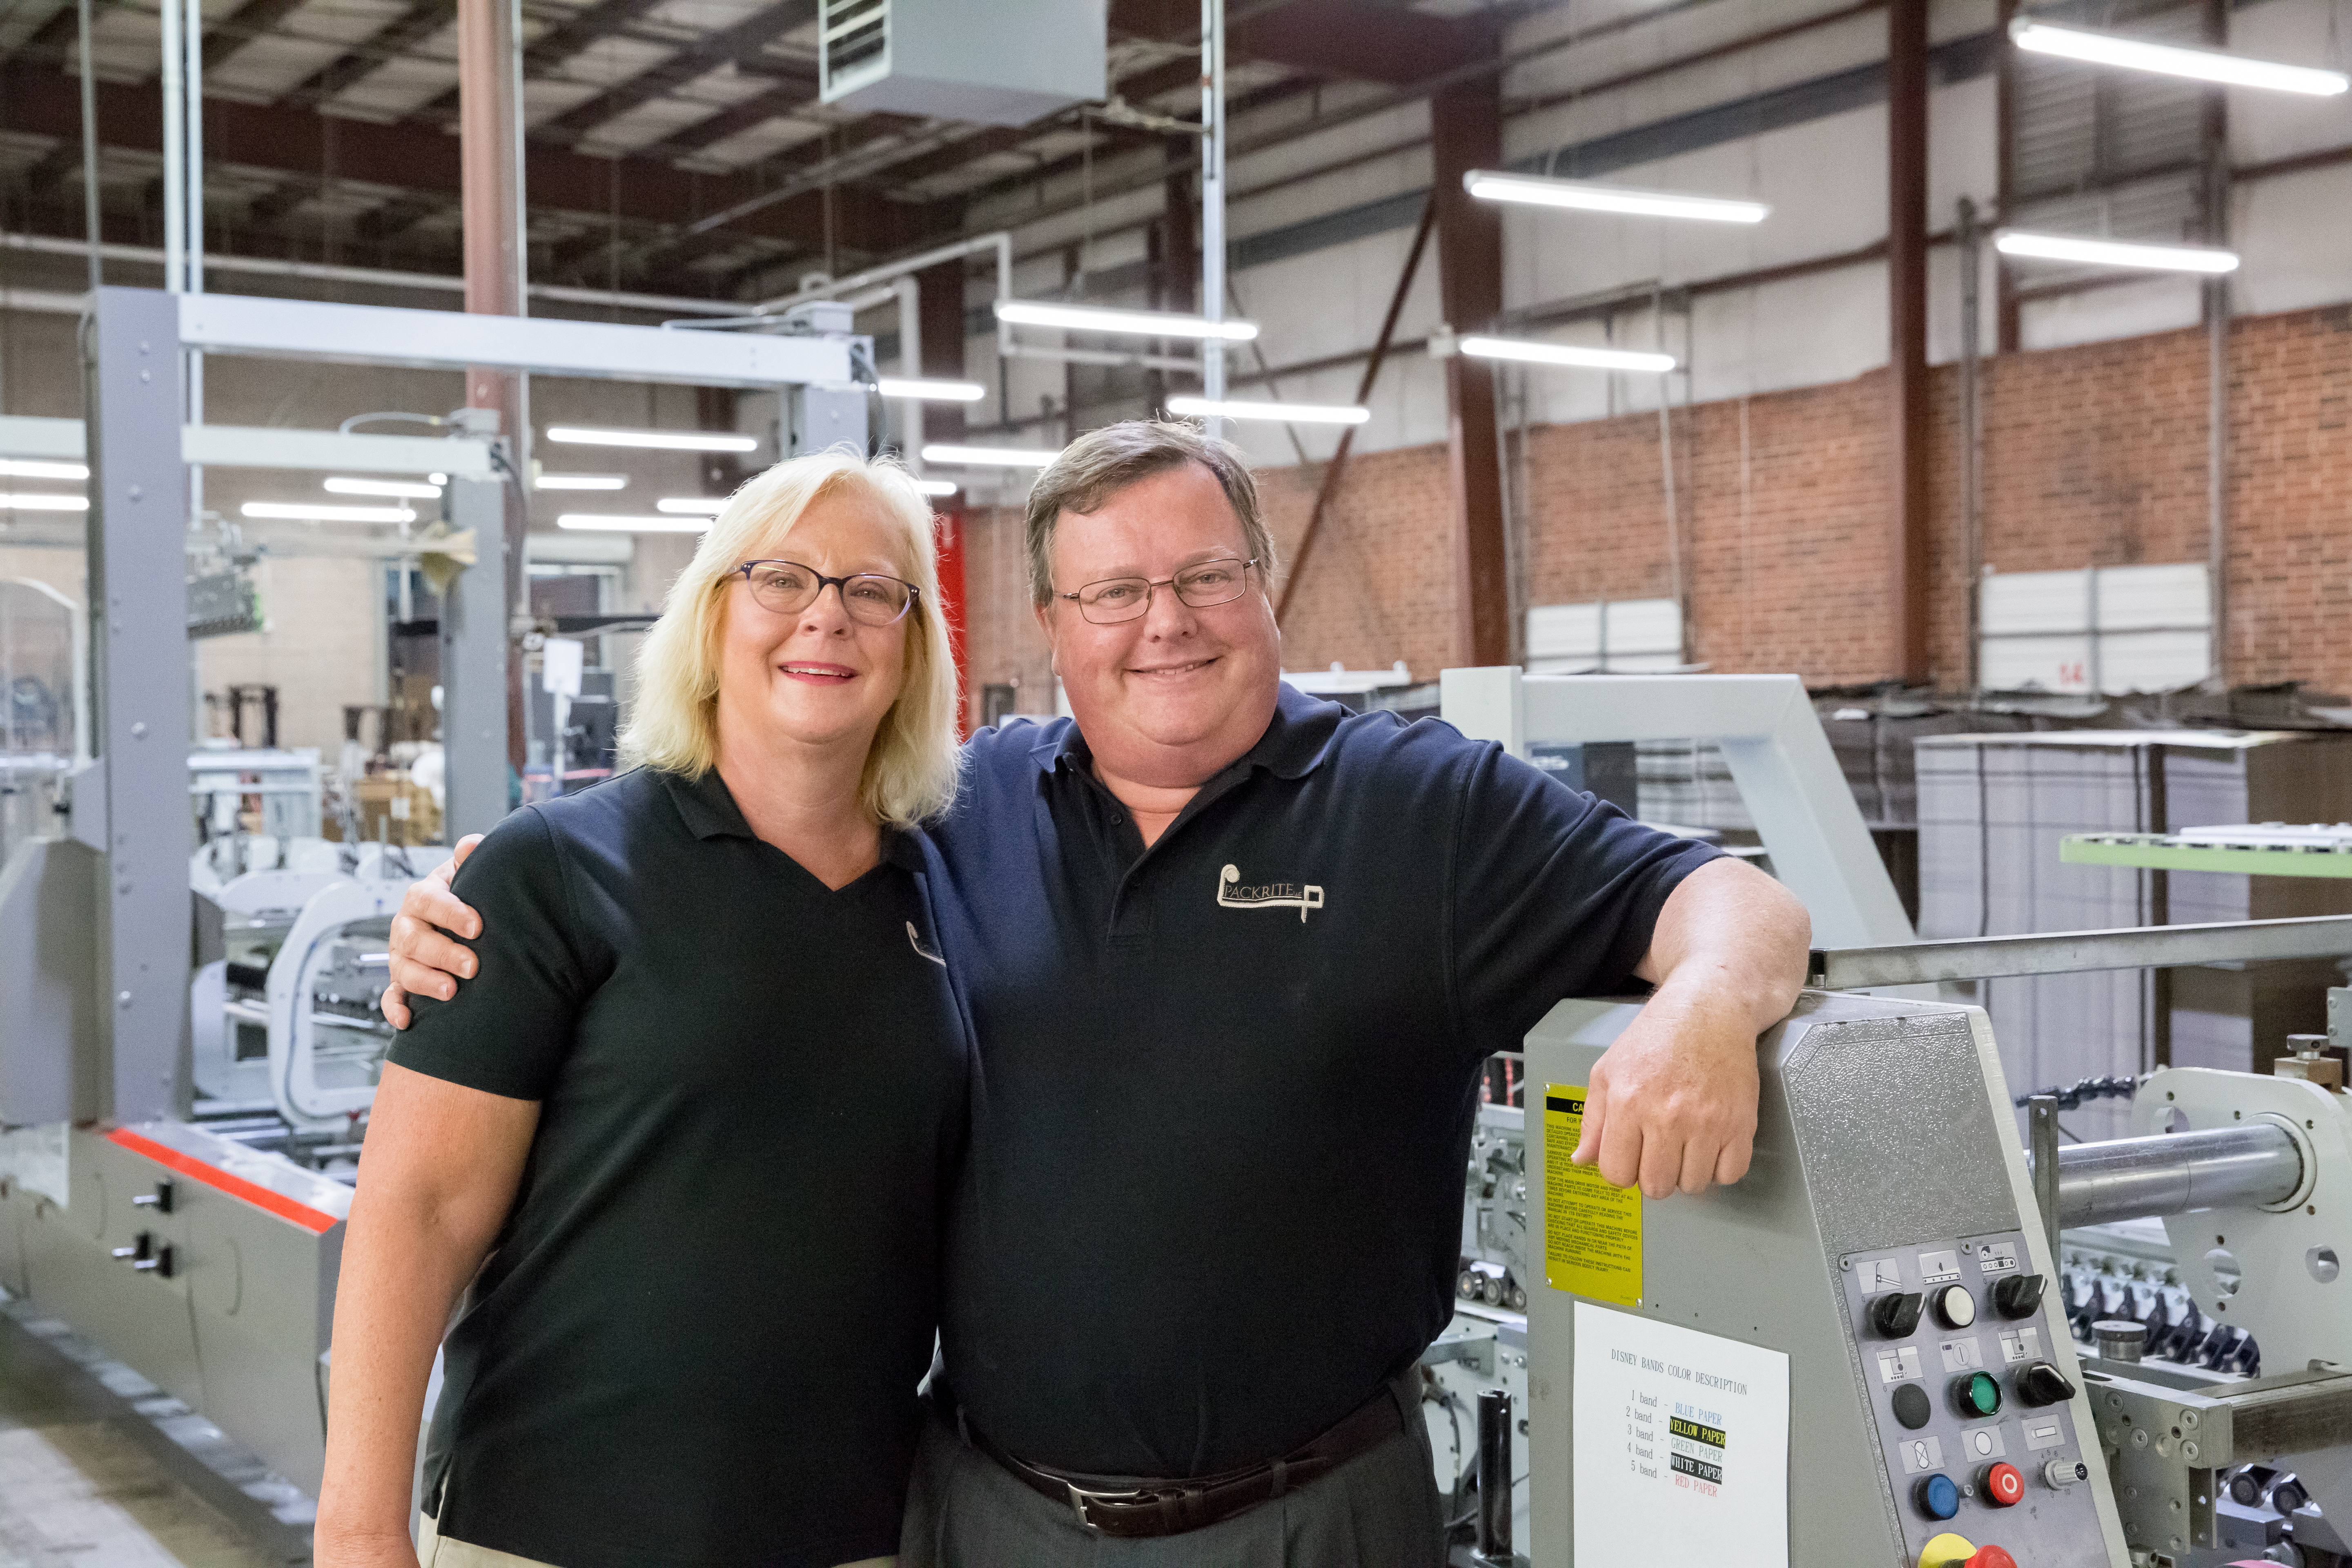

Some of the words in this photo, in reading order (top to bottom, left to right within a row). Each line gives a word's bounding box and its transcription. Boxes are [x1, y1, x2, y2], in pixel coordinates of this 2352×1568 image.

[1225, 883, 1294, 898] PACKRITE
[1612, 1349, 1637, 1366] DISNEY
[1642, 1357, 1664, 1373] BANDS
[1668, 1365, 1691, 1381] COLOR
[1696, 1372, 1747, 1396] DESCRIPTION
[1626, 1406, 1630, 1417] 2
[1635, 1409, 1652, 1423] band
[1670, 1419, 1697, 1437] YELLOW
[1702, 1428, 1725, 1446] PAPER
[1632, 1390, 1634, 1401] 1
[1640, 1393, 1657, 1407] band
[1675, 1403, 1694, 1418] BLUE
[1699, 1409, 1722, 1426] PAPER
[1627, 1442, 1631, 1452] 4
[1636, 1445, 1653, 1459] band
[1671, 1455, 1694, 1472] WHITE
[1698, 1463, 1722, 1481] PAPER
[1628, 1424, 1632, 1435] 3
[1636, 1427, 1653, 1442] band
[1671, 1437, 1694, 1454] GREEN
[1699, 1445, 1722, 1463] PAPER
[1631, 1460, 1635, 1471] 5
[1640, 1463, 1657, 1479] band
[1675, 1474, 1689, 1488] RED
[1694, 1480, 1717, 1497] PAPER
